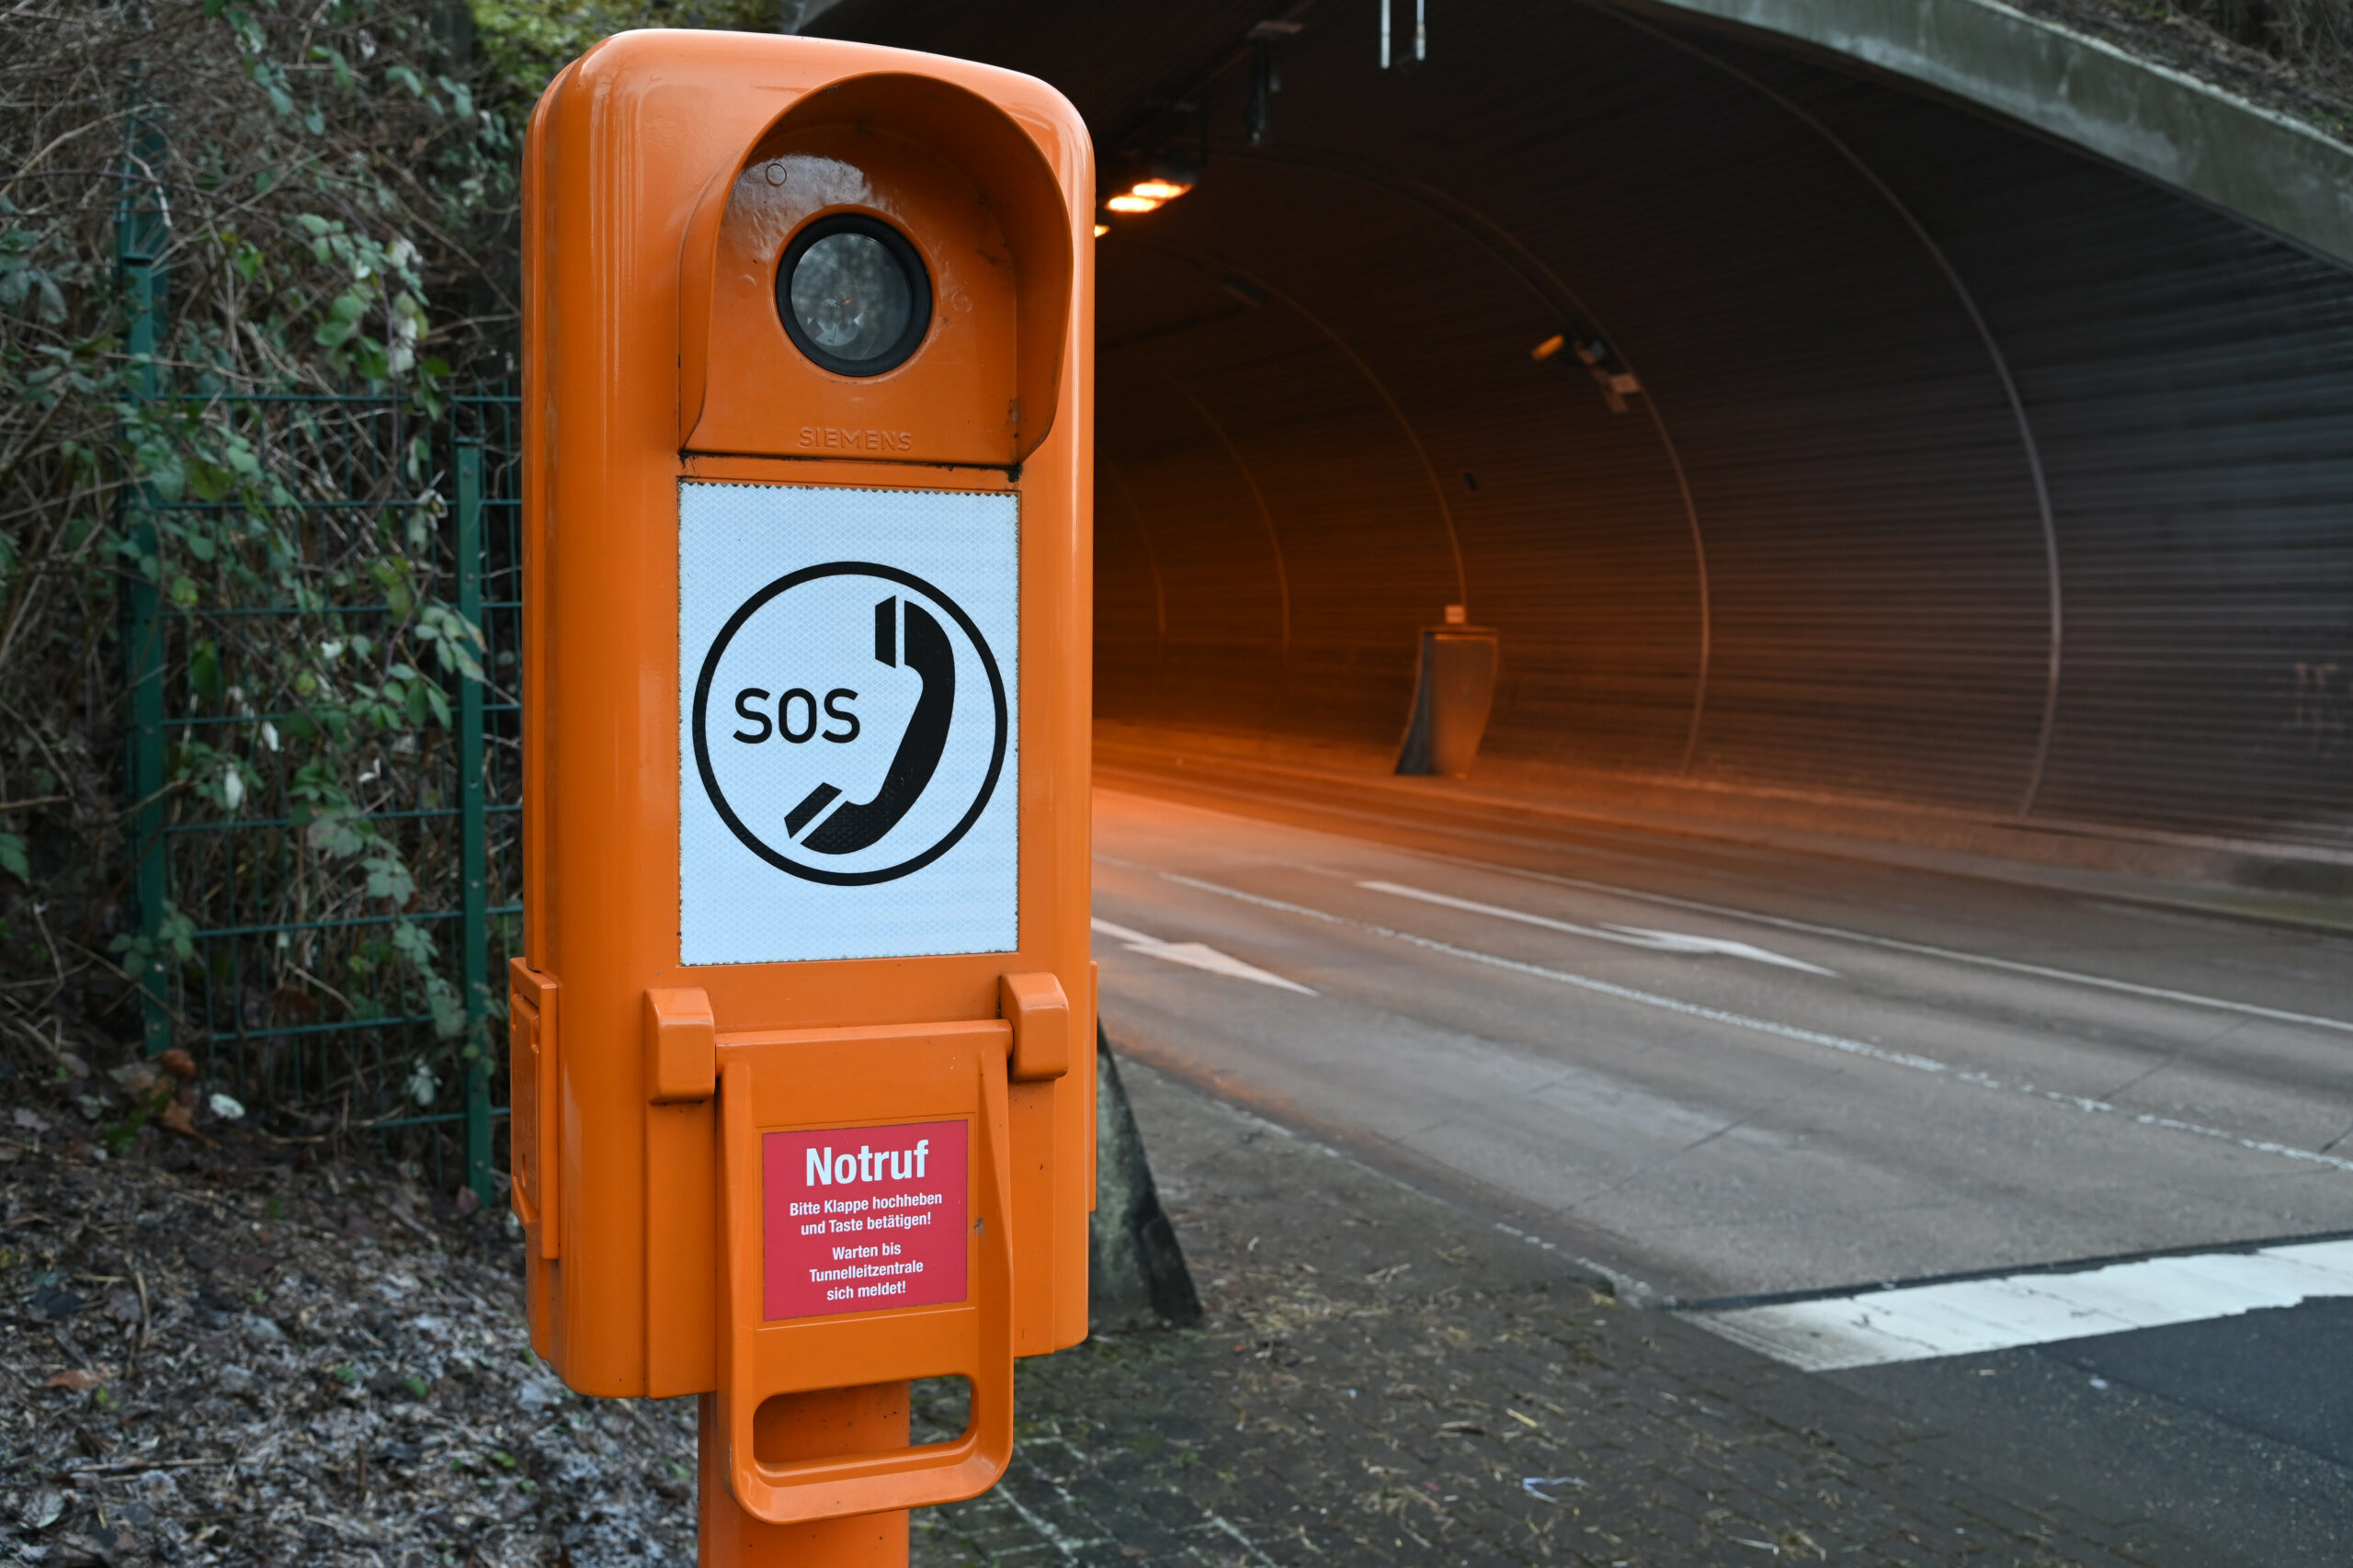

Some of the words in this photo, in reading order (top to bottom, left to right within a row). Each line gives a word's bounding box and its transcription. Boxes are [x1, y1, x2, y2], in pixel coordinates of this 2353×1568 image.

[797, 426, 912, 451] SIEMENS
[733, 687, 860, 744] SOS
[806, 1140, 928, 1187] Notruf
[790, 1202, 821, 1216] Bitte
[824, 1199, 869, 1215] Klappe
[872, 1193, 942, 1210] hochheben
[801, 1221, 825, 1235] und
[829, 1219, 863, 1233] Taste
[867, 1212, 931, 1230] betätigen!
[832, 1245, 879, 1260] Warten
[881, 1243, 902, 1256] bis
[809, 1260, 924, 1282] Tunnelleitzentrale
[826, 1286, 854, 1301] sich
[858, 1280, 906, 1298] meldet!
